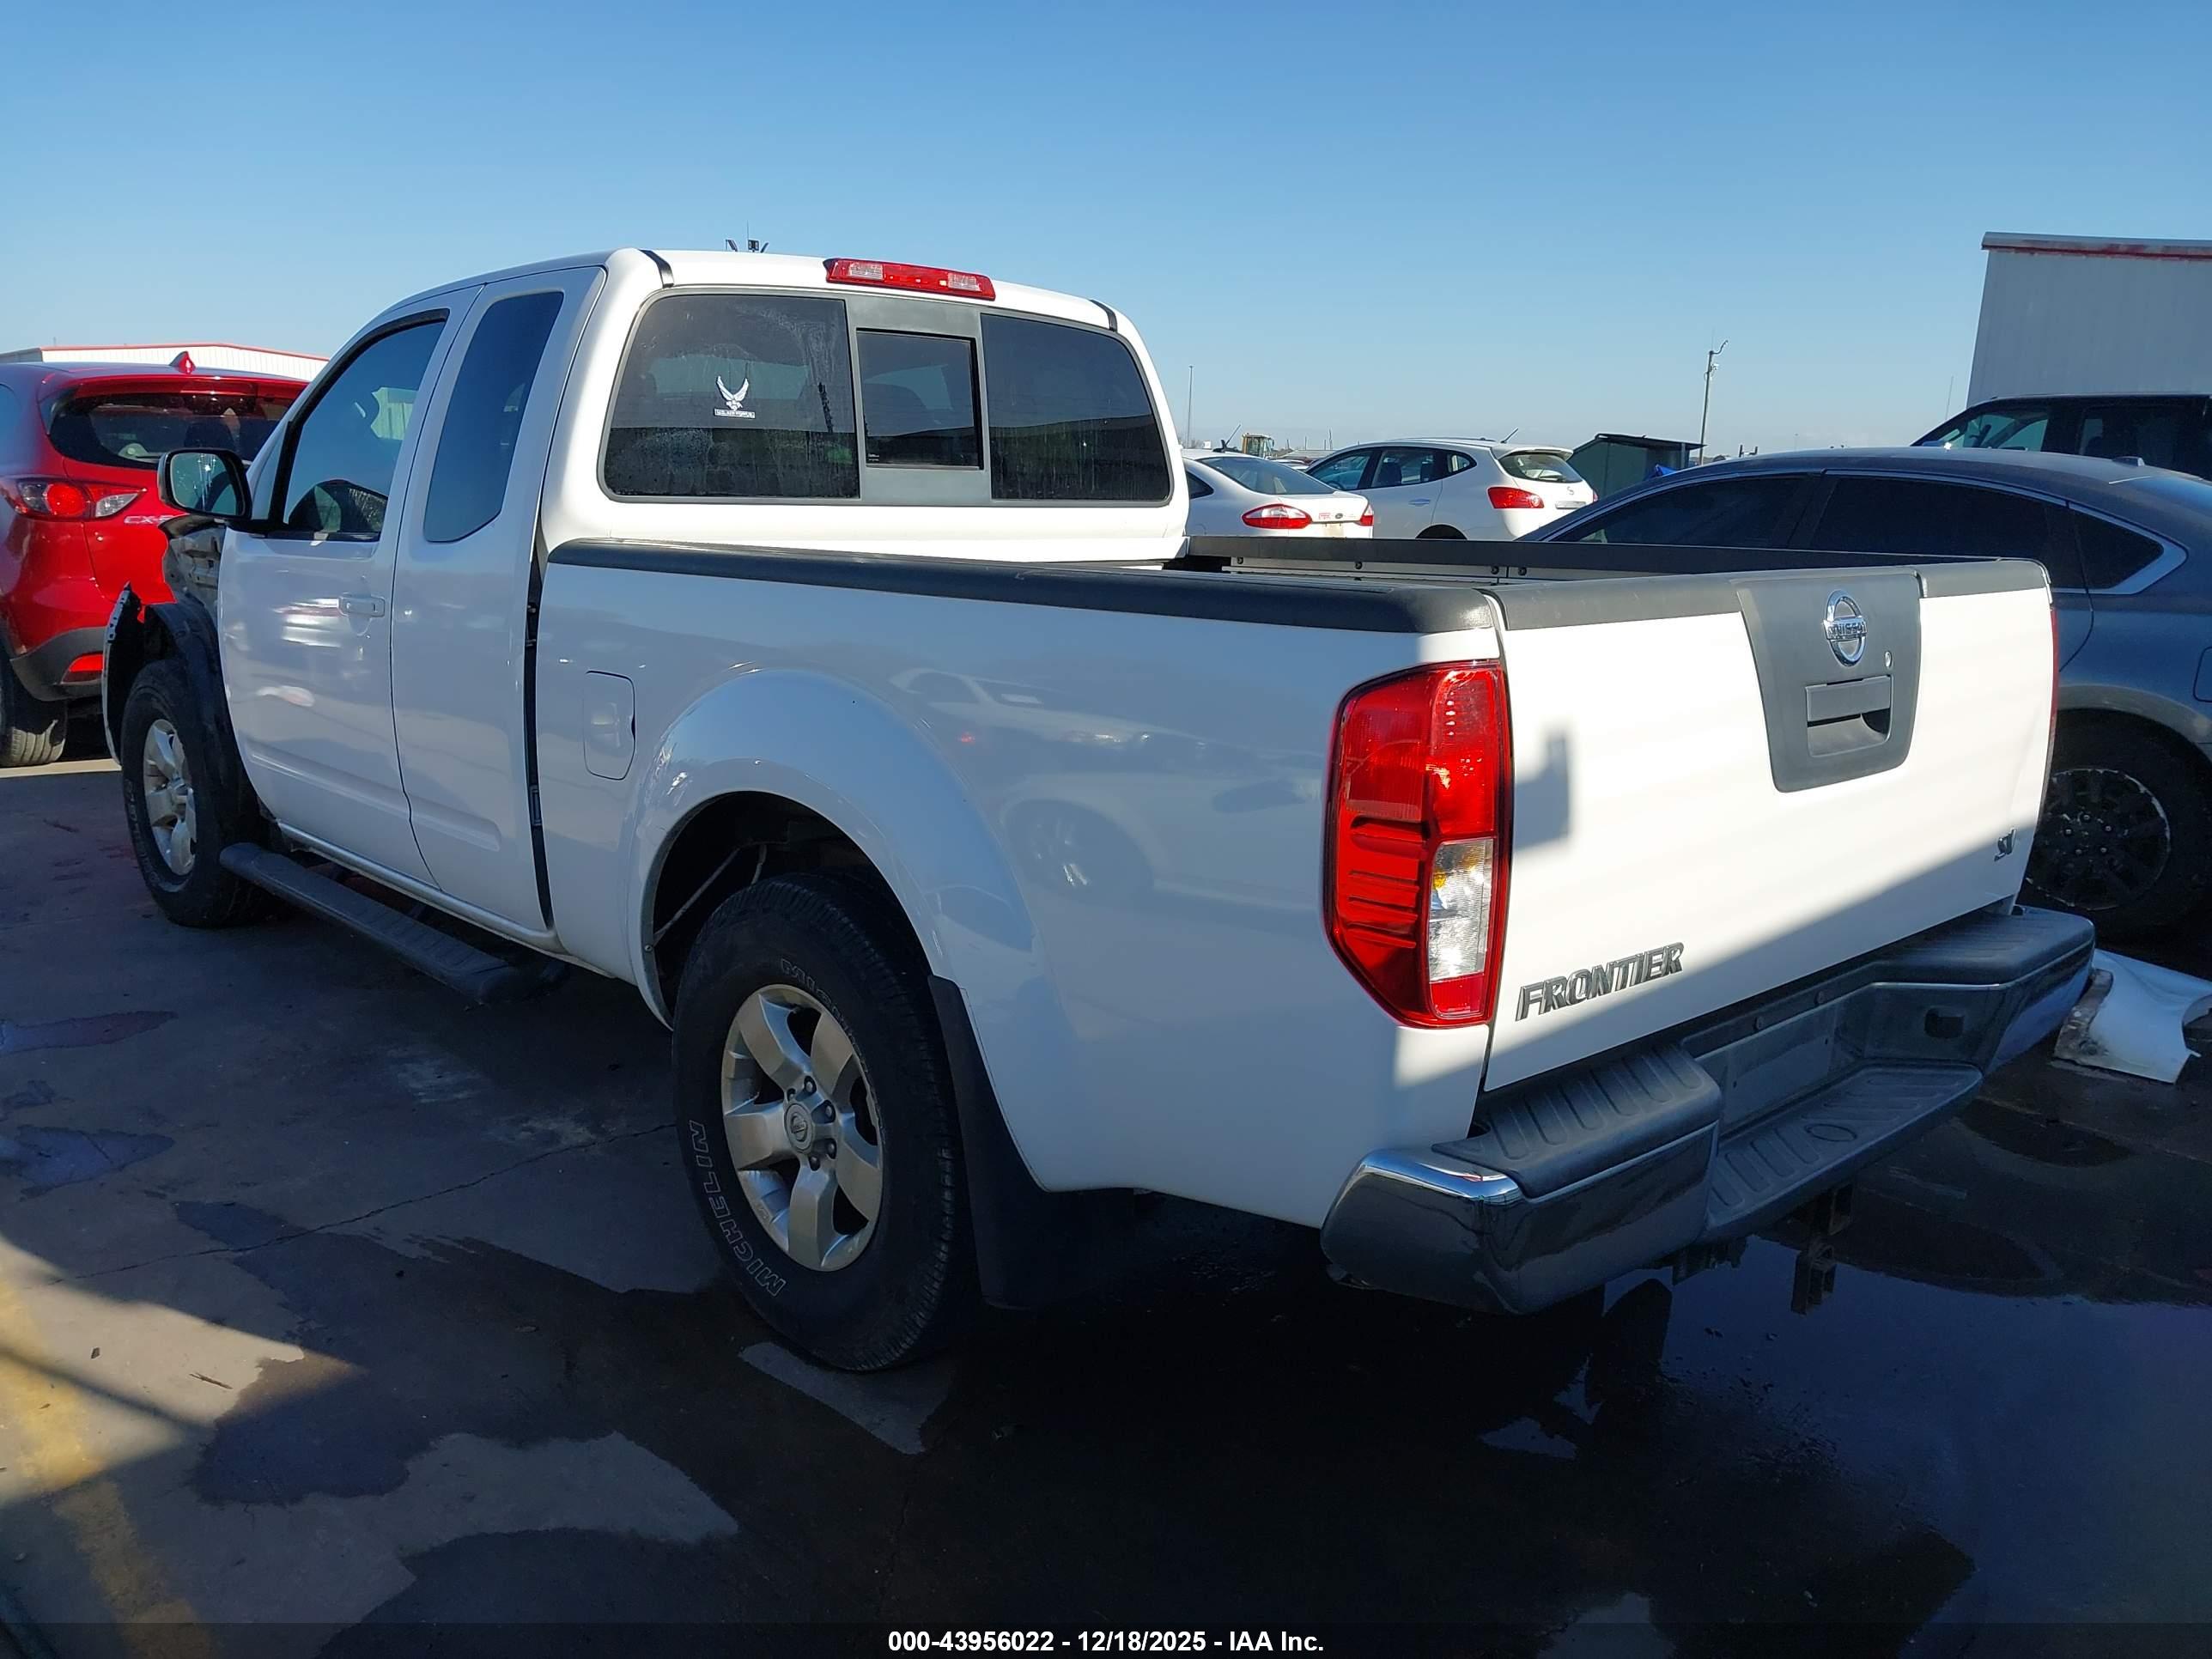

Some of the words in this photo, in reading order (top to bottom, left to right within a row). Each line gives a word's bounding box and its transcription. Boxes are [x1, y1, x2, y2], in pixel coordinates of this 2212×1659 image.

[1826, 621, 1867, 637] NISSAN
[1515, 942, 1684, 1022] FRONTIER
[689, 1120, 787, 1297] MICHELIN
